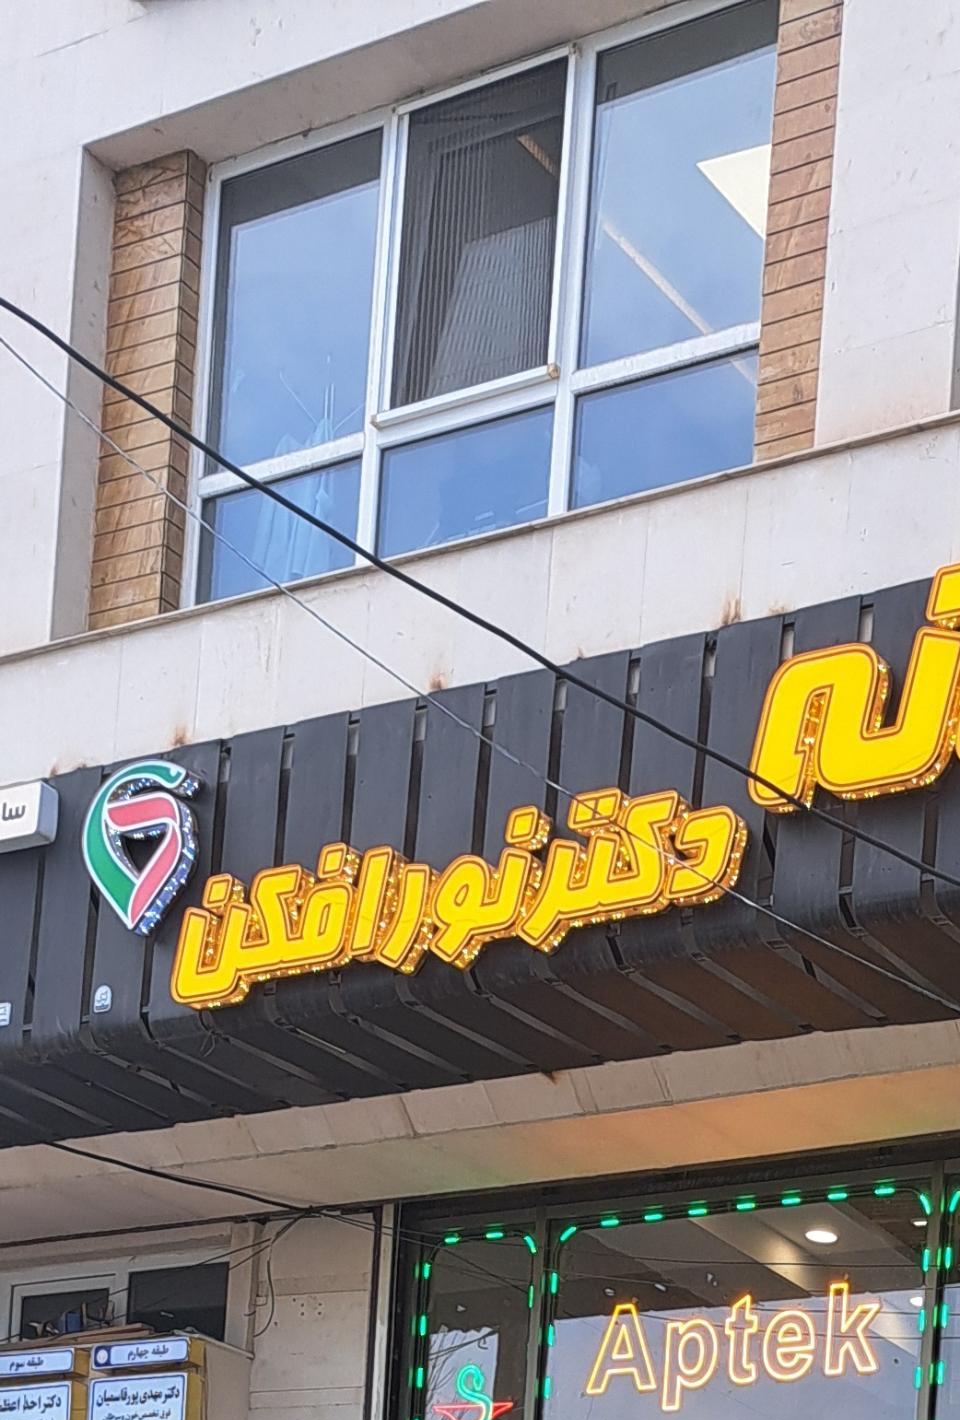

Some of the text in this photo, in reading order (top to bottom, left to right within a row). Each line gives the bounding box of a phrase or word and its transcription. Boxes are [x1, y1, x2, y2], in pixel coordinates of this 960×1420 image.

[517, 787, 747, 953] دکتر
[586, 1281, 881, 1412] Aptek
[41, 1393, 62, 1414] دکتر
[162, 1386, 180, 1404] دکتر
